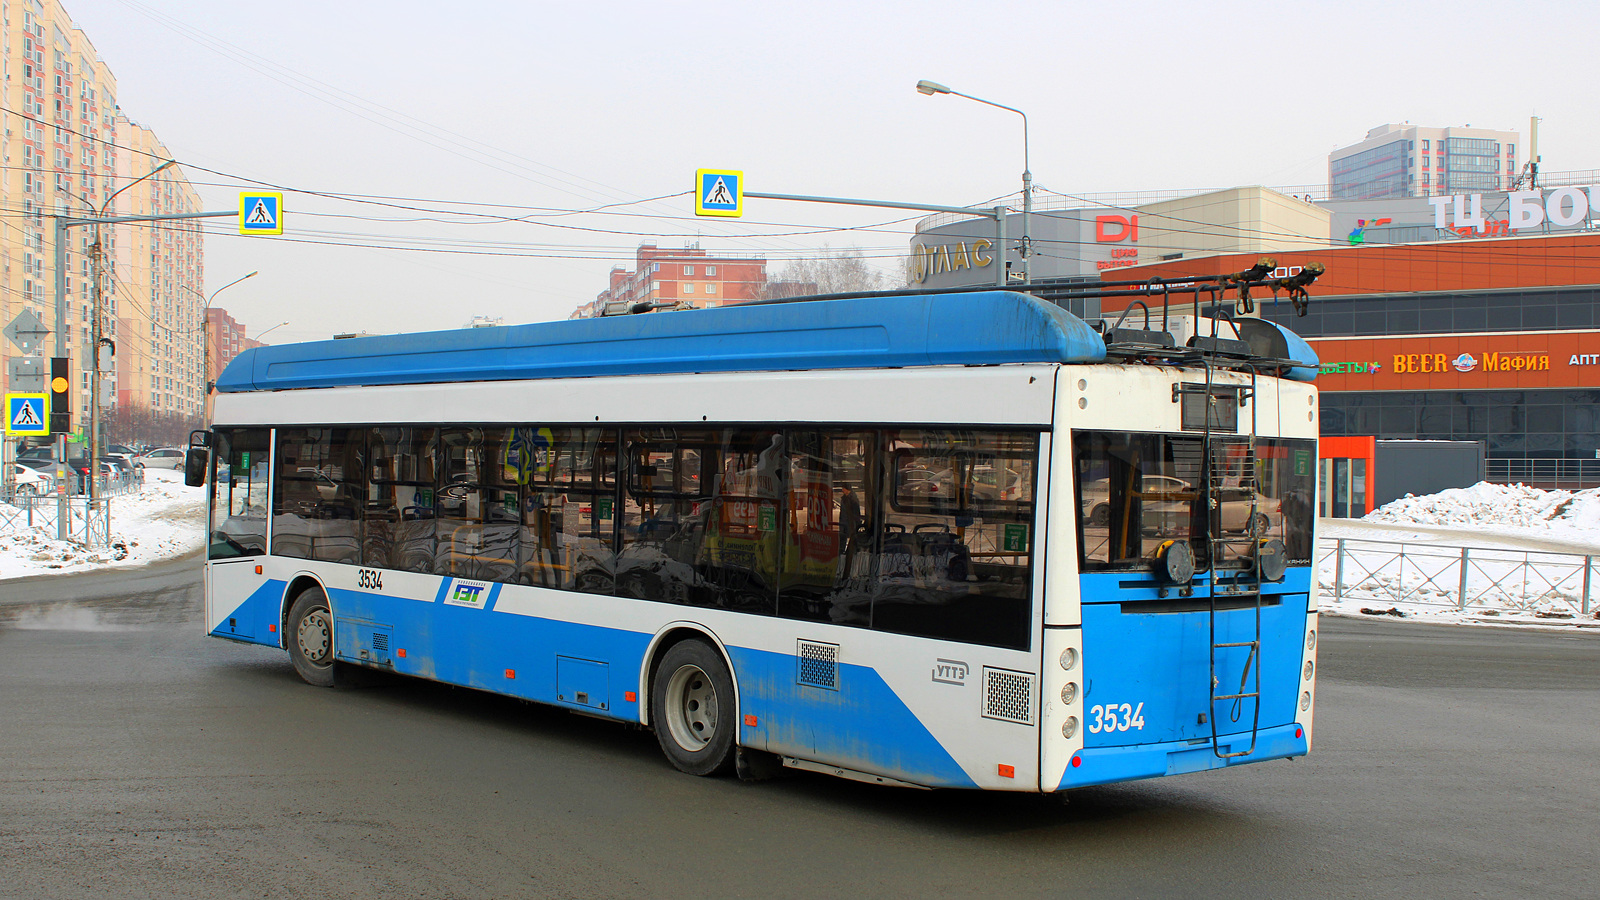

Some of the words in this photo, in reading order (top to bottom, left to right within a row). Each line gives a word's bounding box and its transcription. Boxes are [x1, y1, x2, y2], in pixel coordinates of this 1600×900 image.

[1429, 194, 1486, 233] ТЦ
[1393, 353, 1448, 373] BEER
[1482, 352, 1550, 372] Мафия
[358, 569, 383, 590] 3534
[1088, 702, 1145, 734] 3534
